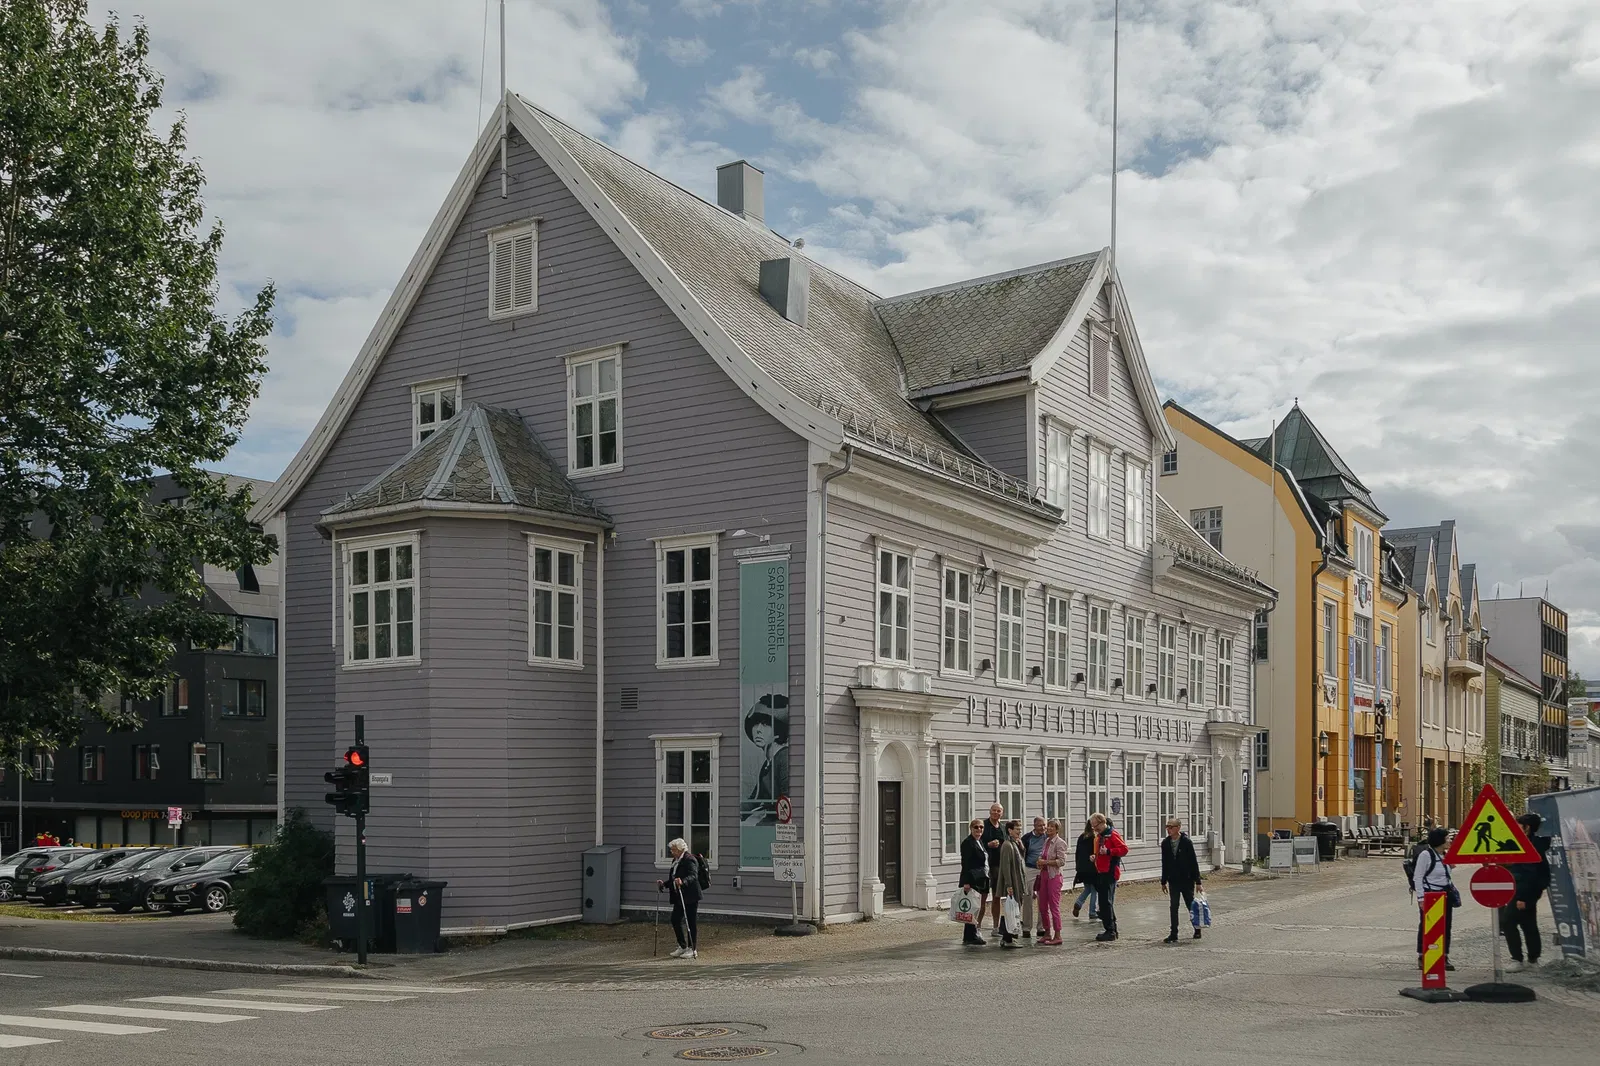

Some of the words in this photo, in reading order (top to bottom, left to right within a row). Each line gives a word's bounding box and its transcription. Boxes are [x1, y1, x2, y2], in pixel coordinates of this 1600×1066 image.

[767, 567, 776, 599] SARA
[776, 566, 785, 600] CORA
[767, 602, 776, 663] FABRICIUS
[776, 603, 785, 651] SANDEL
[966, 694, 1121, 738] PERSPEKTIVET
[1134, 714, 1192, 743] MUSEUM
[1374, 707, 1384, 742] KINO
[142, 809, 159, 821] prix
